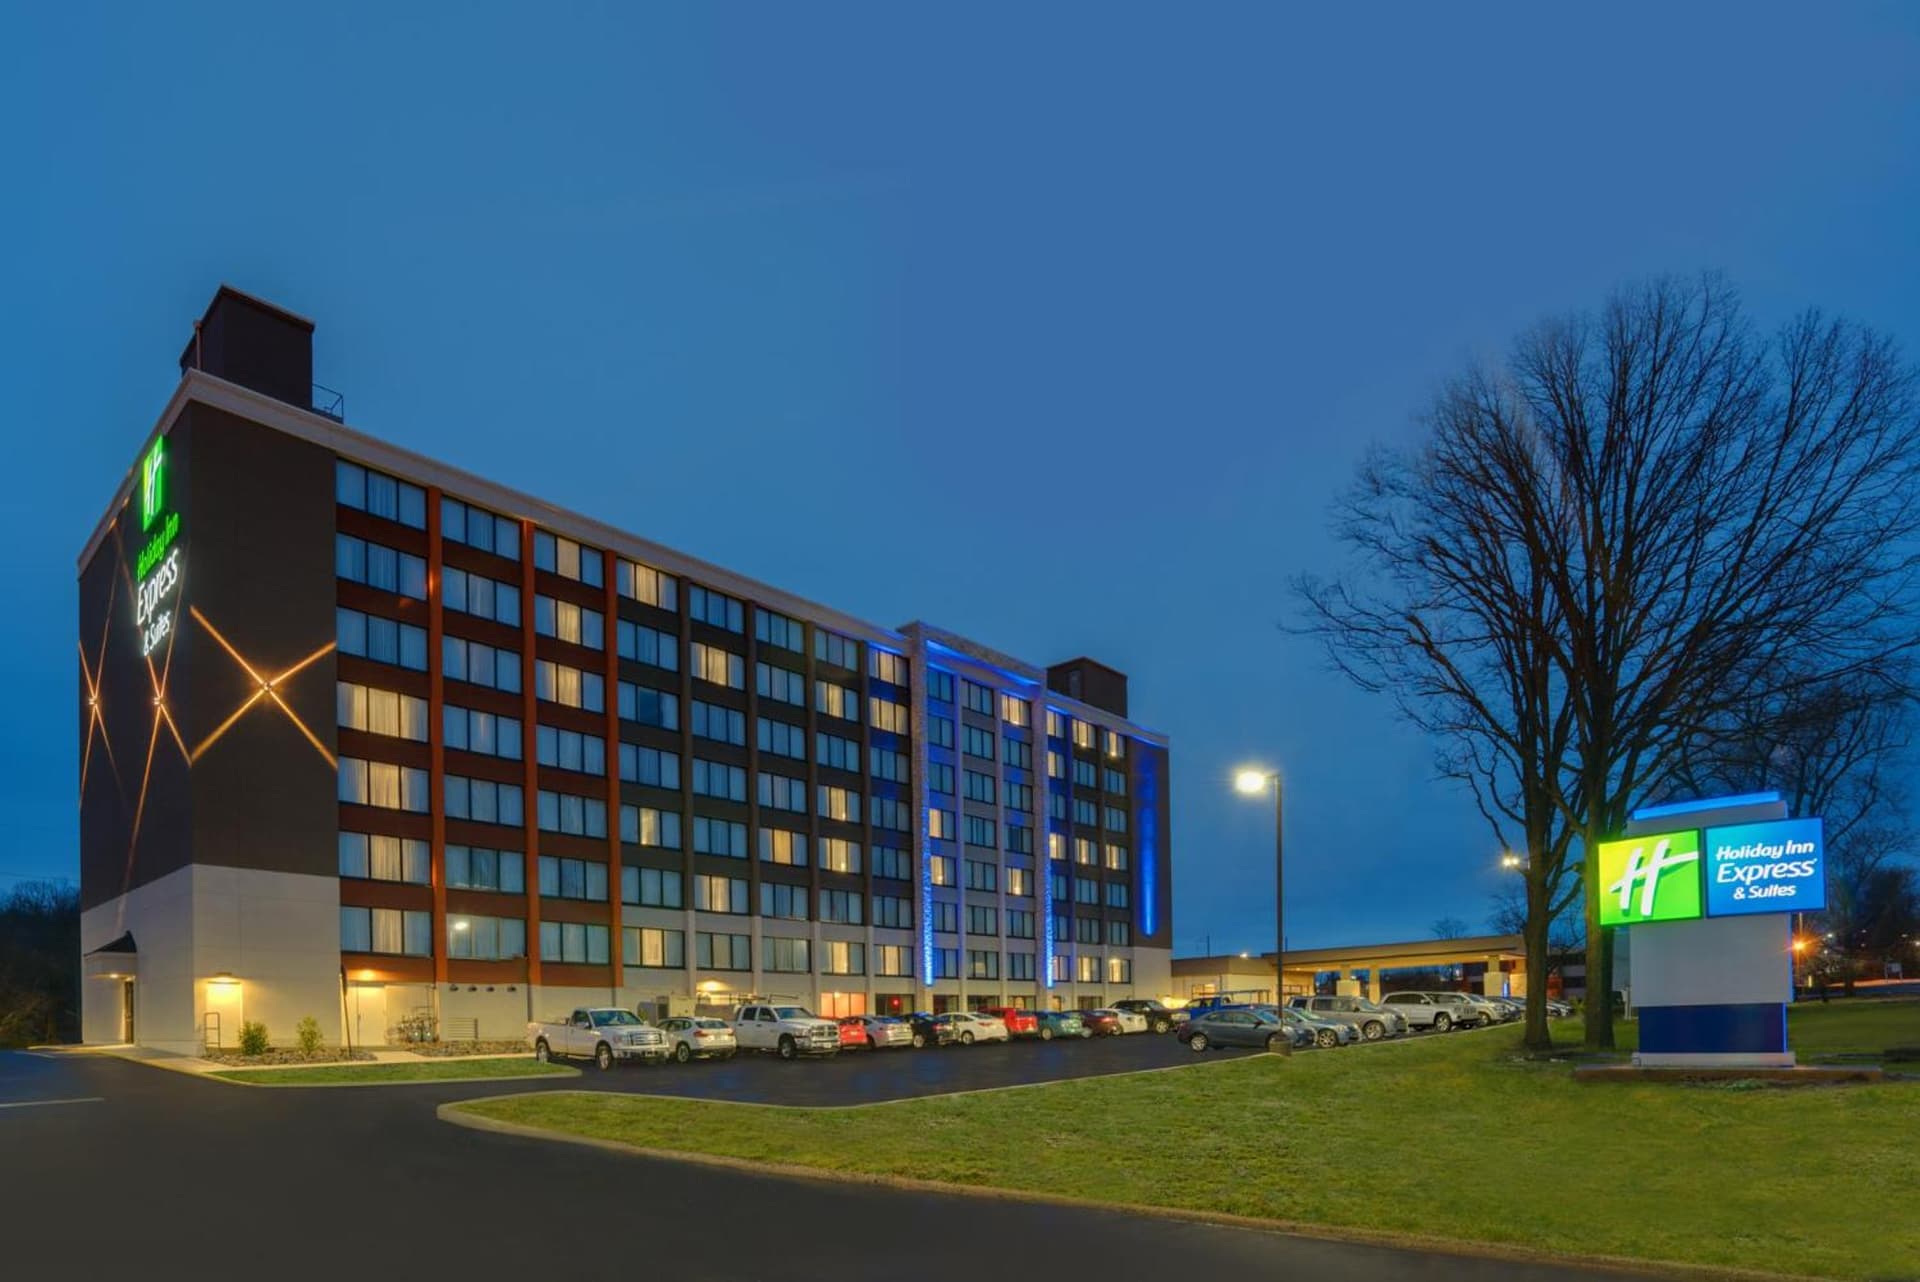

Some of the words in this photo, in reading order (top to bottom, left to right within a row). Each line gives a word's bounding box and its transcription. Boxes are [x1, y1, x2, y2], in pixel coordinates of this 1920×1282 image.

[137, 532, 164, 582] Holiday
[165, 512, 179, 544] Inn
[137, 549, 178, 626] Express
[150, 611, 170, 650] Suites
[1715, 844, 1783, 862] Holiday
[1786, 840, 1814, 855] Inn
[1716, 860, 1815, 885] Express
[1733, 887, 1745, 900] &
[1748, 884, 1796, 899] Suites
